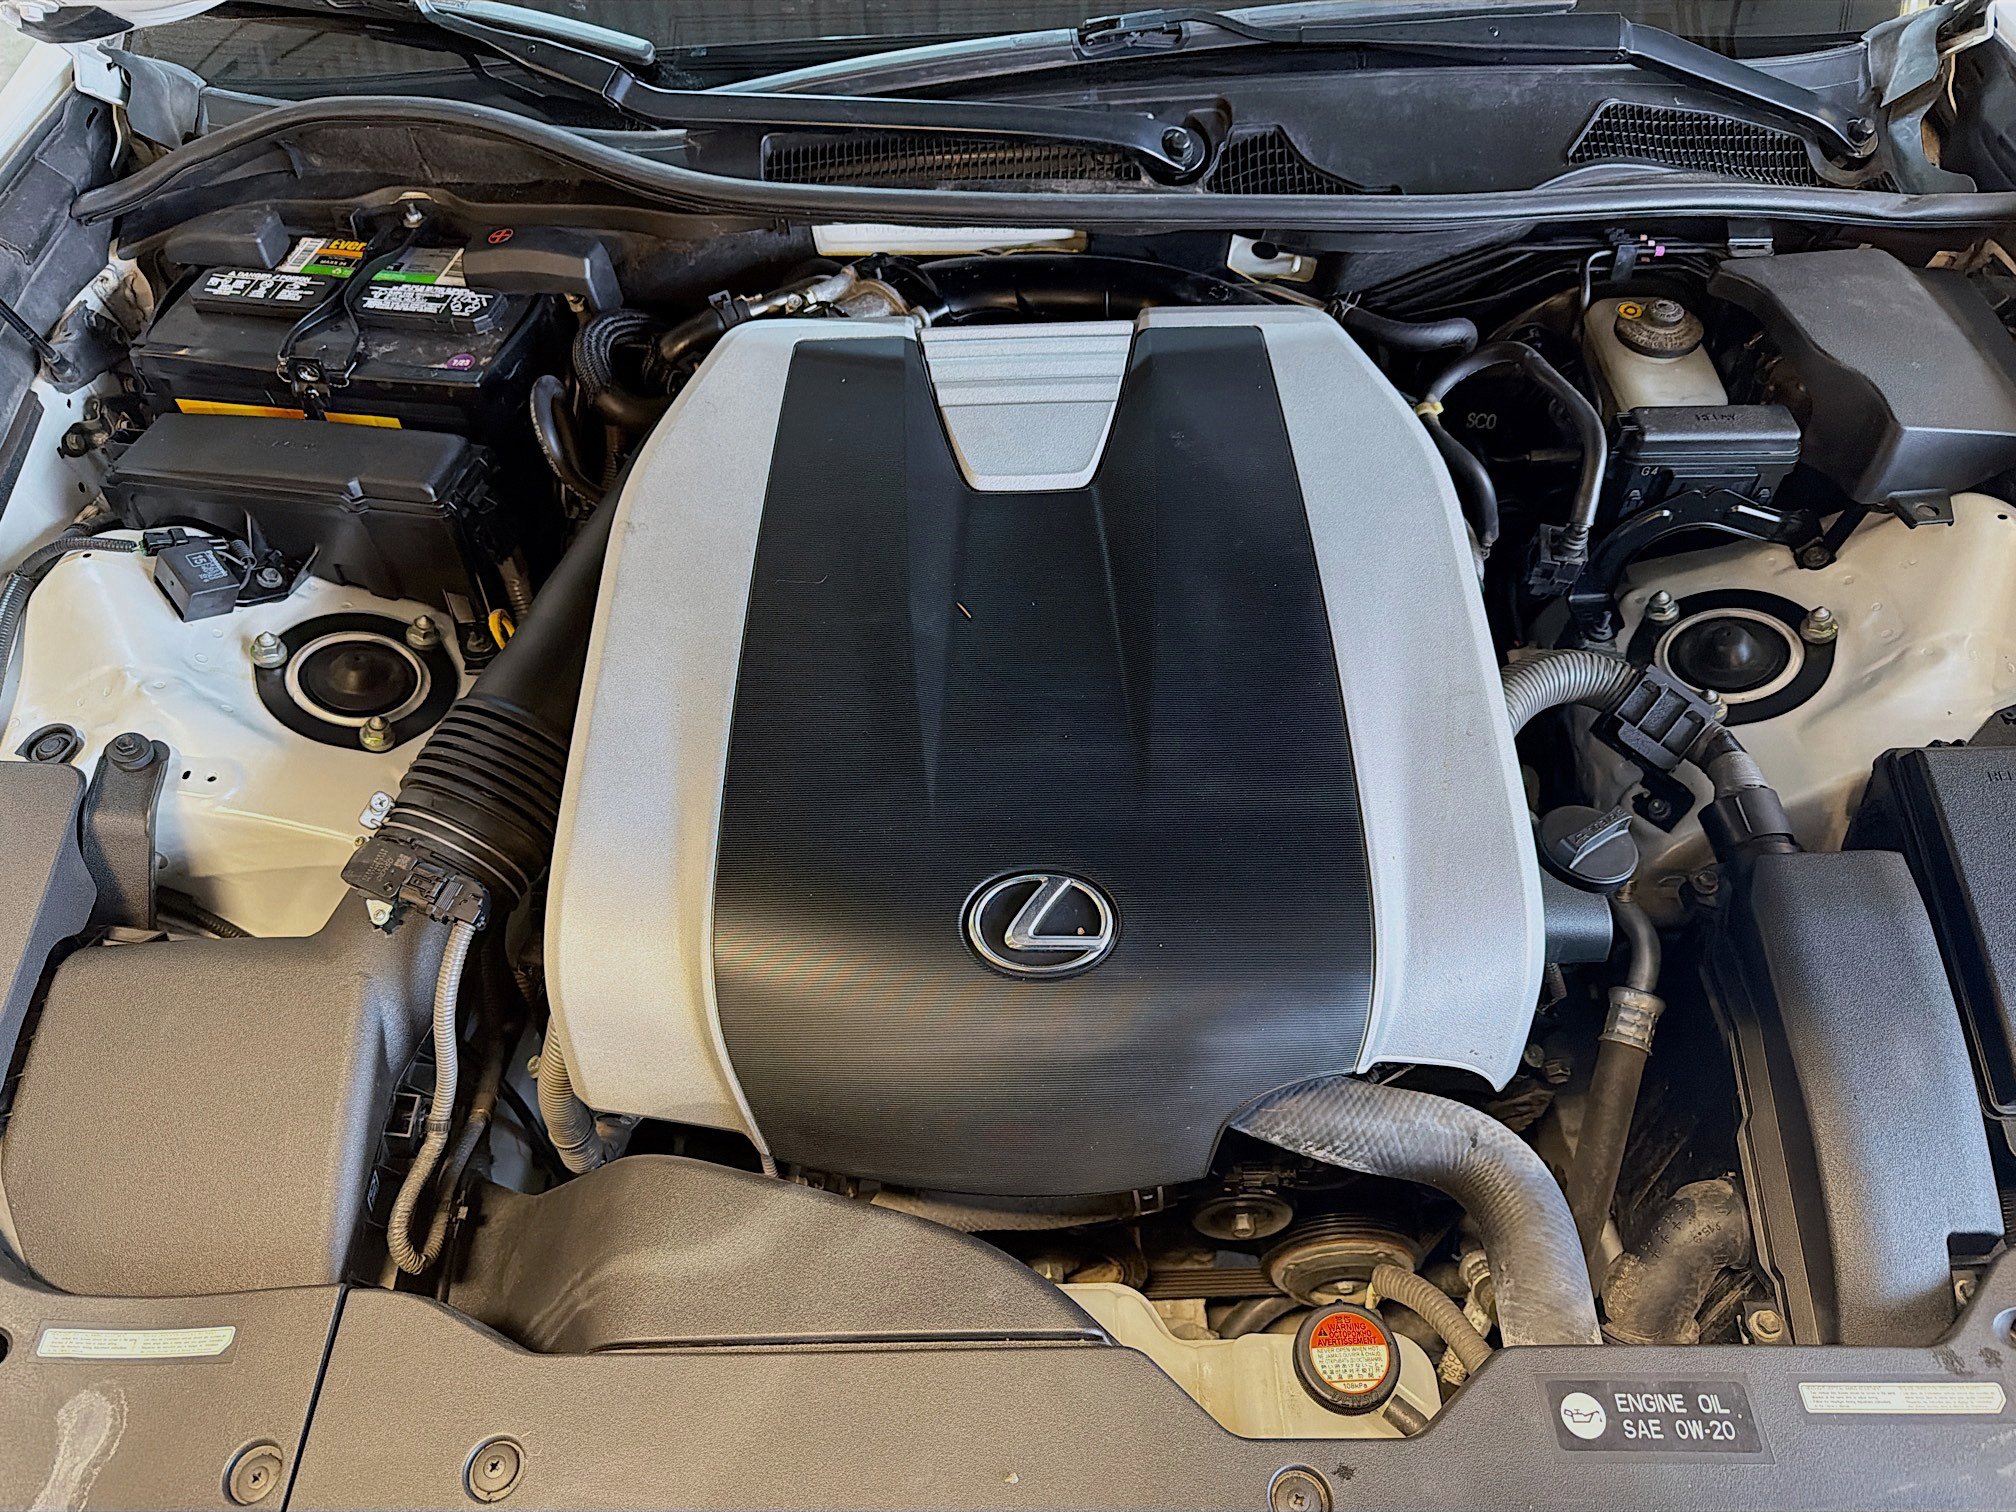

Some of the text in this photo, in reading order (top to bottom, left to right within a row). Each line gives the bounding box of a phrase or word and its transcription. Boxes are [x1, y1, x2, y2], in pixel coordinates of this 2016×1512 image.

[236, 271, 273, 280] DANGER
[192, 554, 207, 565] 15
[1327, 1322, 1367, 1332] WARNING
[1317, 1336, 1377, 1347] AVERTISSEMENT
[1614, 1393, 1731, 1415] ENGINE OIL
[1622, 1418, 1737, 1441] SAE 0W-20
